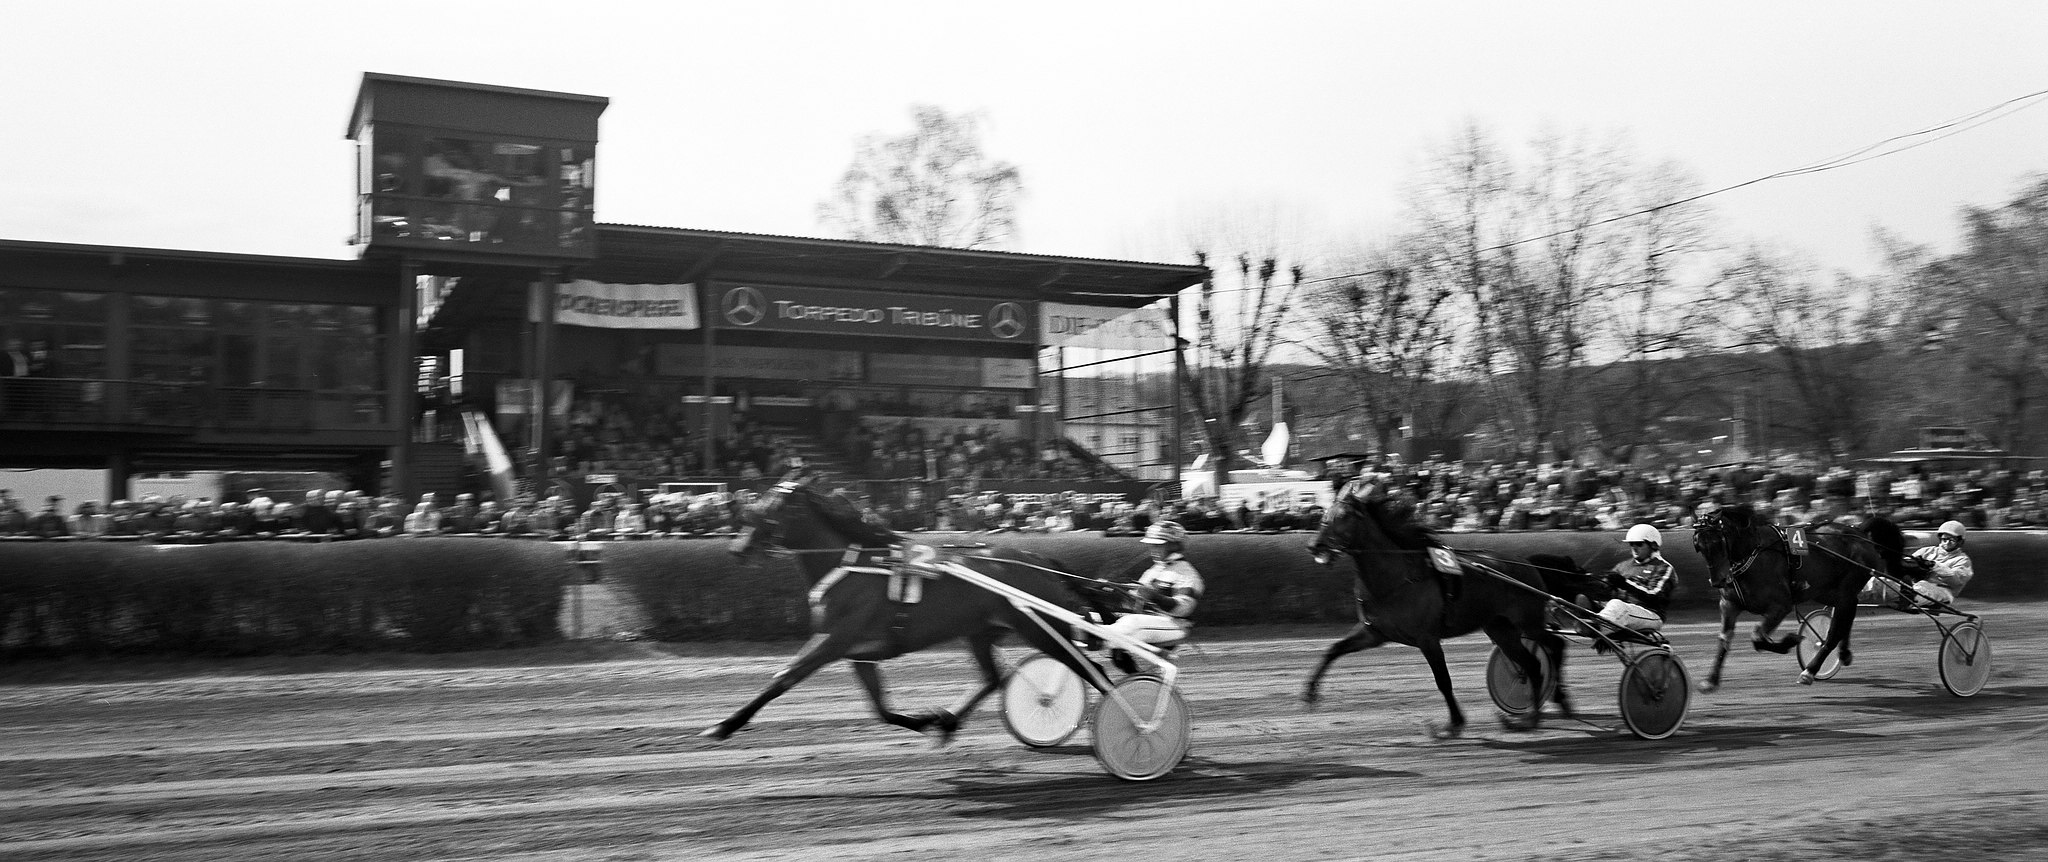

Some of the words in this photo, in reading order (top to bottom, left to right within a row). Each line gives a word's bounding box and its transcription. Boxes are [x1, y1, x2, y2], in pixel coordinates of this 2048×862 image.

[773, 300, 886, 324] TORPEDO
[1792, 530, 1804, 548] 4
[909, 544, 935, 569] 2
[1434, 549, 1455, 567] 3
